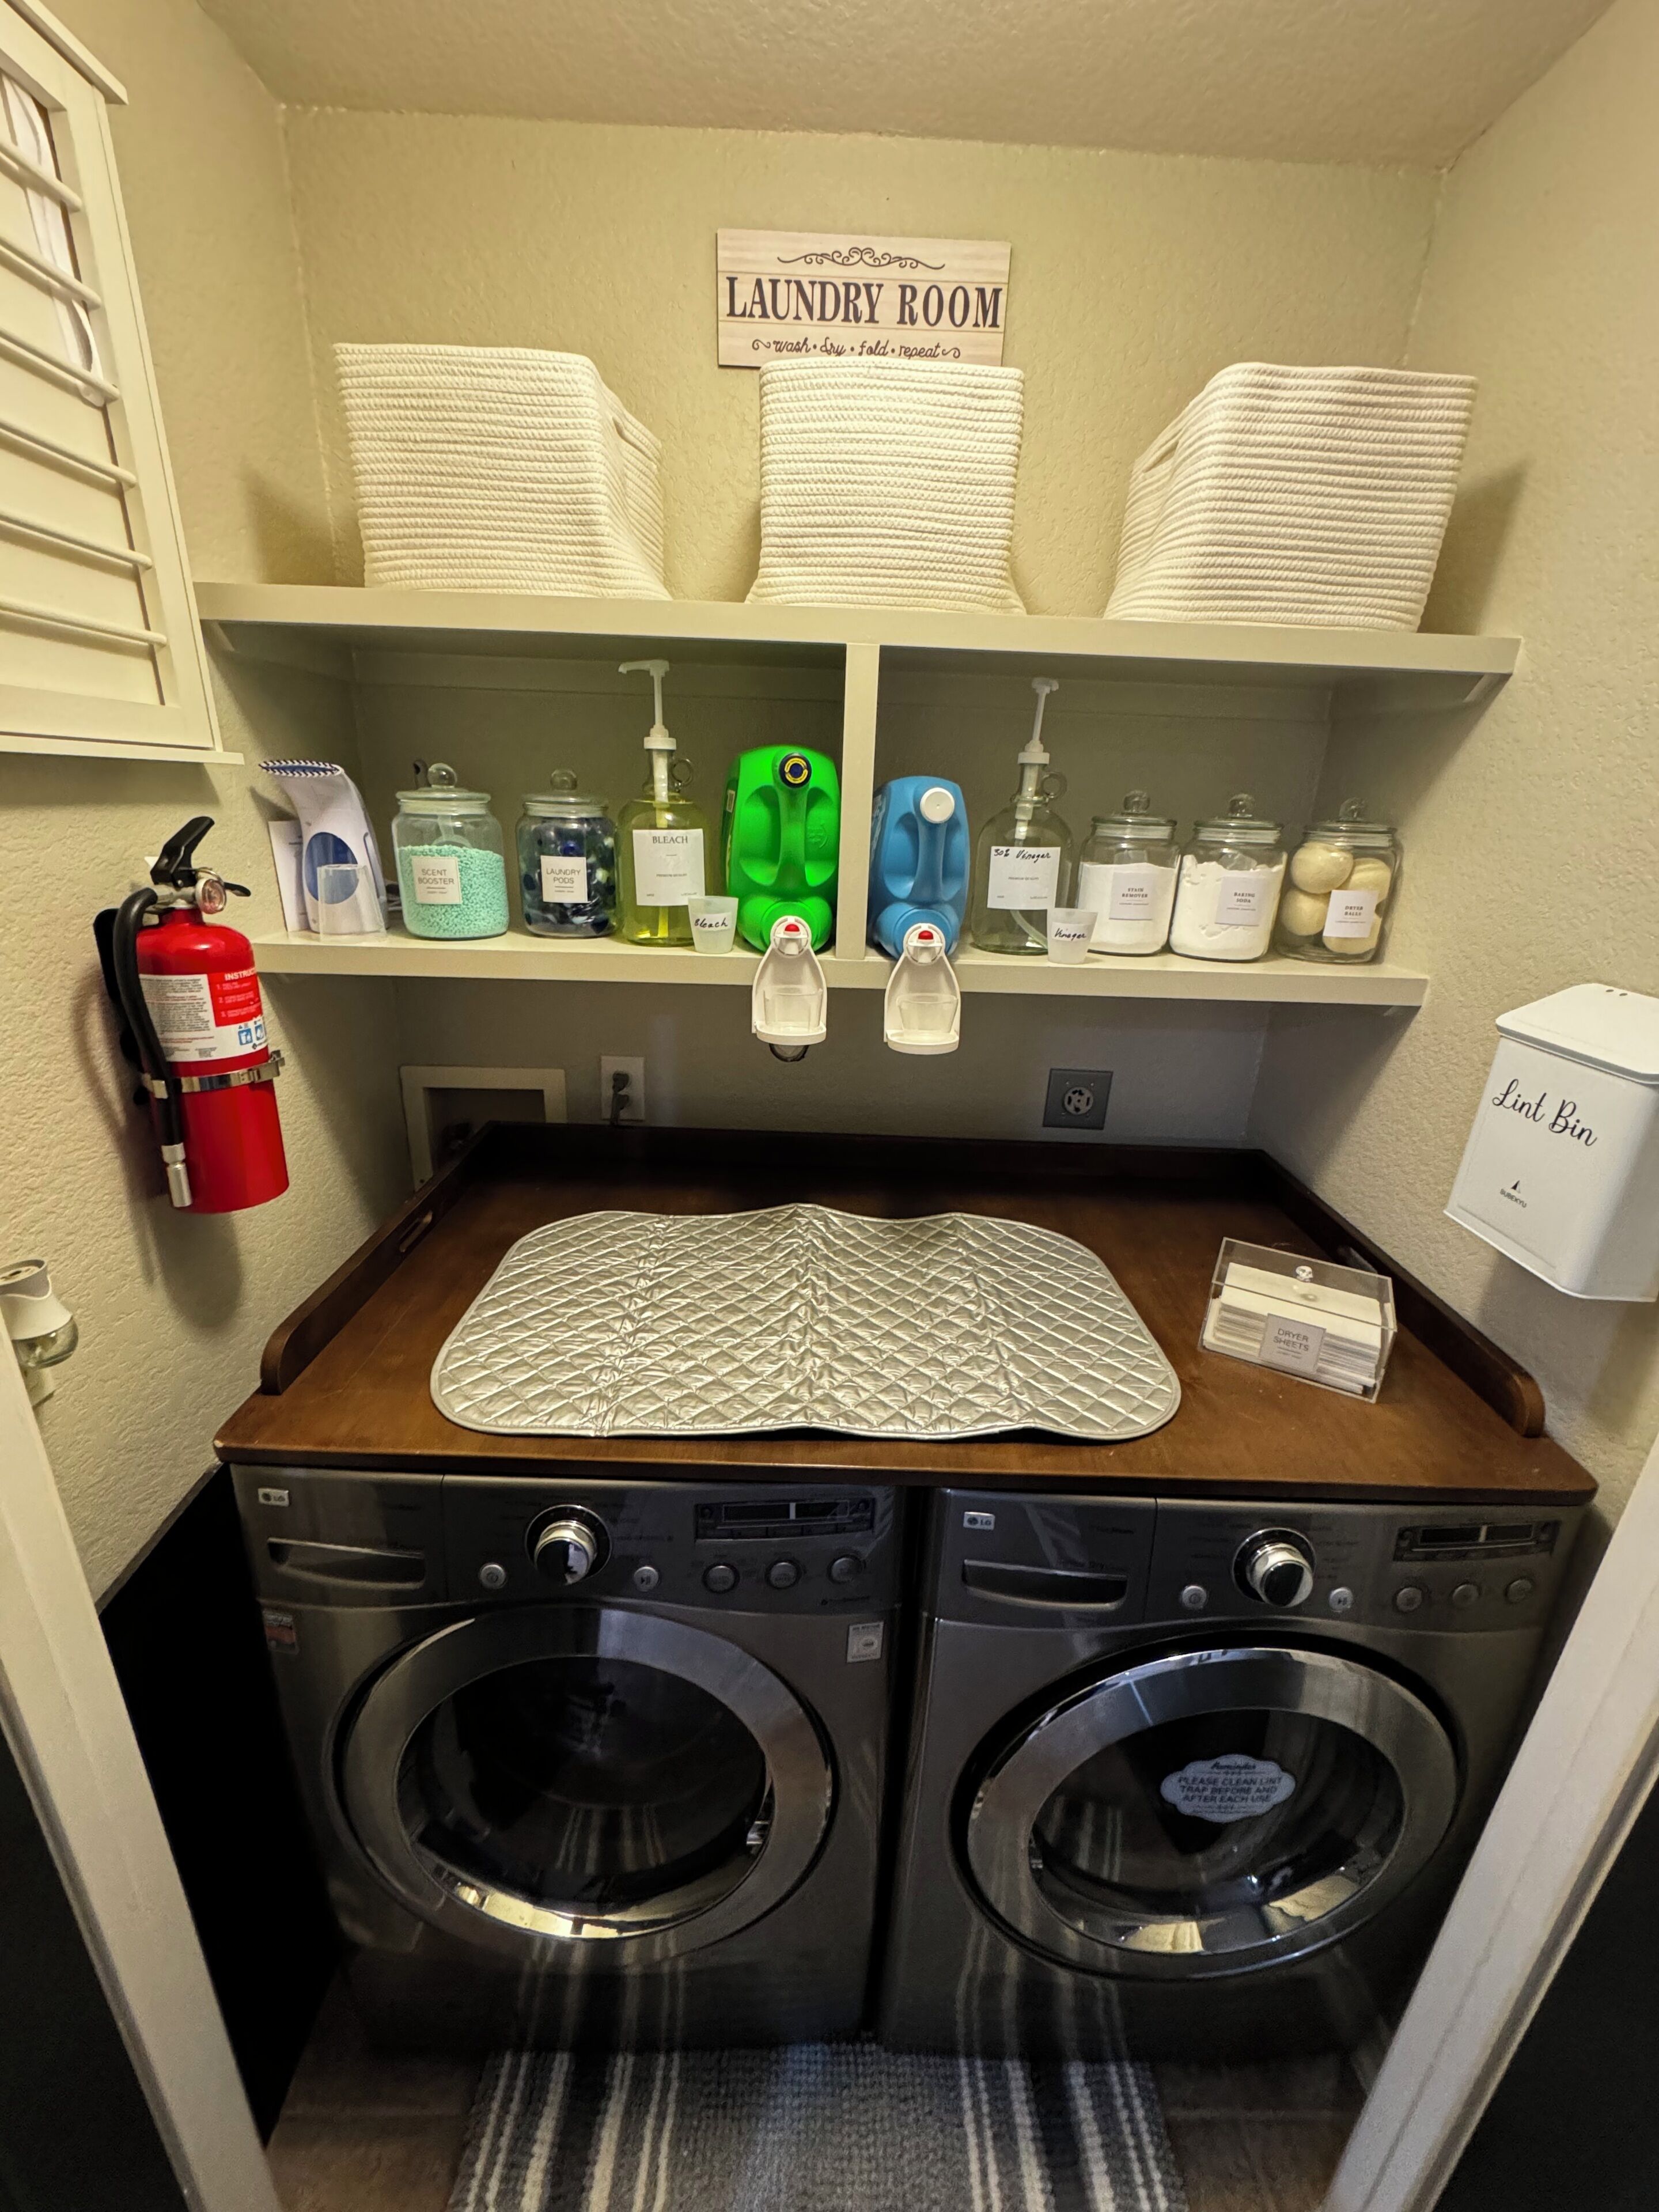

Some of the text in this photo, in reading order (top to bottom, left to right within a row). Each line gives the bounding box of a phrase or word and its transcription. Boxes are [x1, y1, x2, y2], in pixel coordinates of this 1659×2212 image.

[726, 276, 1003, 328] LAUNDRY ROOM
[772, 336, 941, 359] wash dry fold repeat
[652, 835, 688, 844] BLEACH
[421, 868, 447, 876] SCENT
[546, 868, 581, 876] LAUNDRY
[418, 876, 454, 885] BOOSTER
[553, 876, 575, 884] PODS
[694, 917, 729, 929] Bleach
[224, 968, 256, 981] INSTRUC
[1492, 1078, 1598, 1146] Lint Bin
[1277, 1328, 1309, 1342] DRYER
[1273, 1336, 1309, 1351] SHEETS
[1178, 1777, 1218, 1785] PLEASE
[1259, 1776, 1281, 1785] LINT
[1211, 1786, 1252, 1794] BEFORE
[1183, 1794, 1271, 1802] AFTER EACH USE
